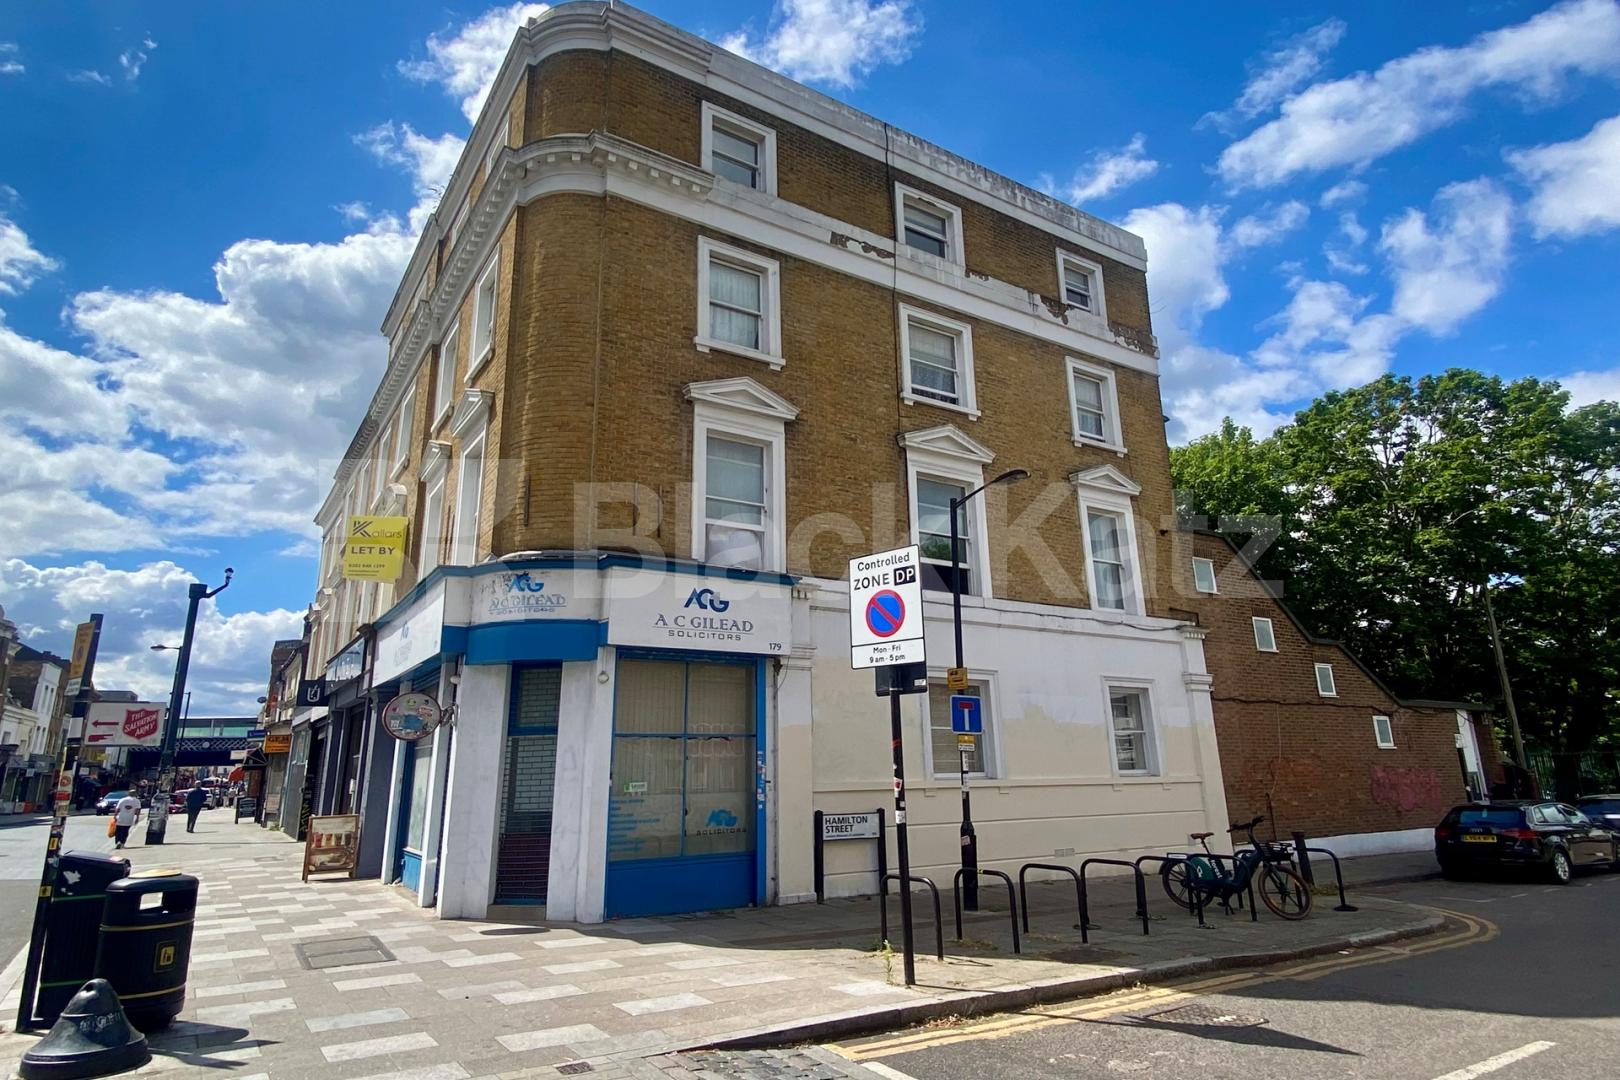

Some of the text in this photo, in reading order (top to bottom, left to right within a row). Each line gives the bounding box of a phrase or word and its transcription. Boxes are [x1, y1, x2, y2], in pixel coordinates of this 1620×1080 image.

[352, 521, 402, 538] Kallars
[351, 546, 395, 555] LET BY
[857, 552, 910, 572] Controlled
[854, 567, 914, 590] ZONE DP
[655, 613, 753, 632] A C GILEAD
[668, 630, 742, 641] SOLICITORS
[769, 643, 782, 651] 179
[892, 645, 901, 653] Fri
[131, 711, 146, 721] THE
[124, 713, 157, 733] SALVATION
[134, 720, 155, 737] ARMY
[825, 816, 868, 825] HAMILTON
[825, 825, 853, 834] STREET
